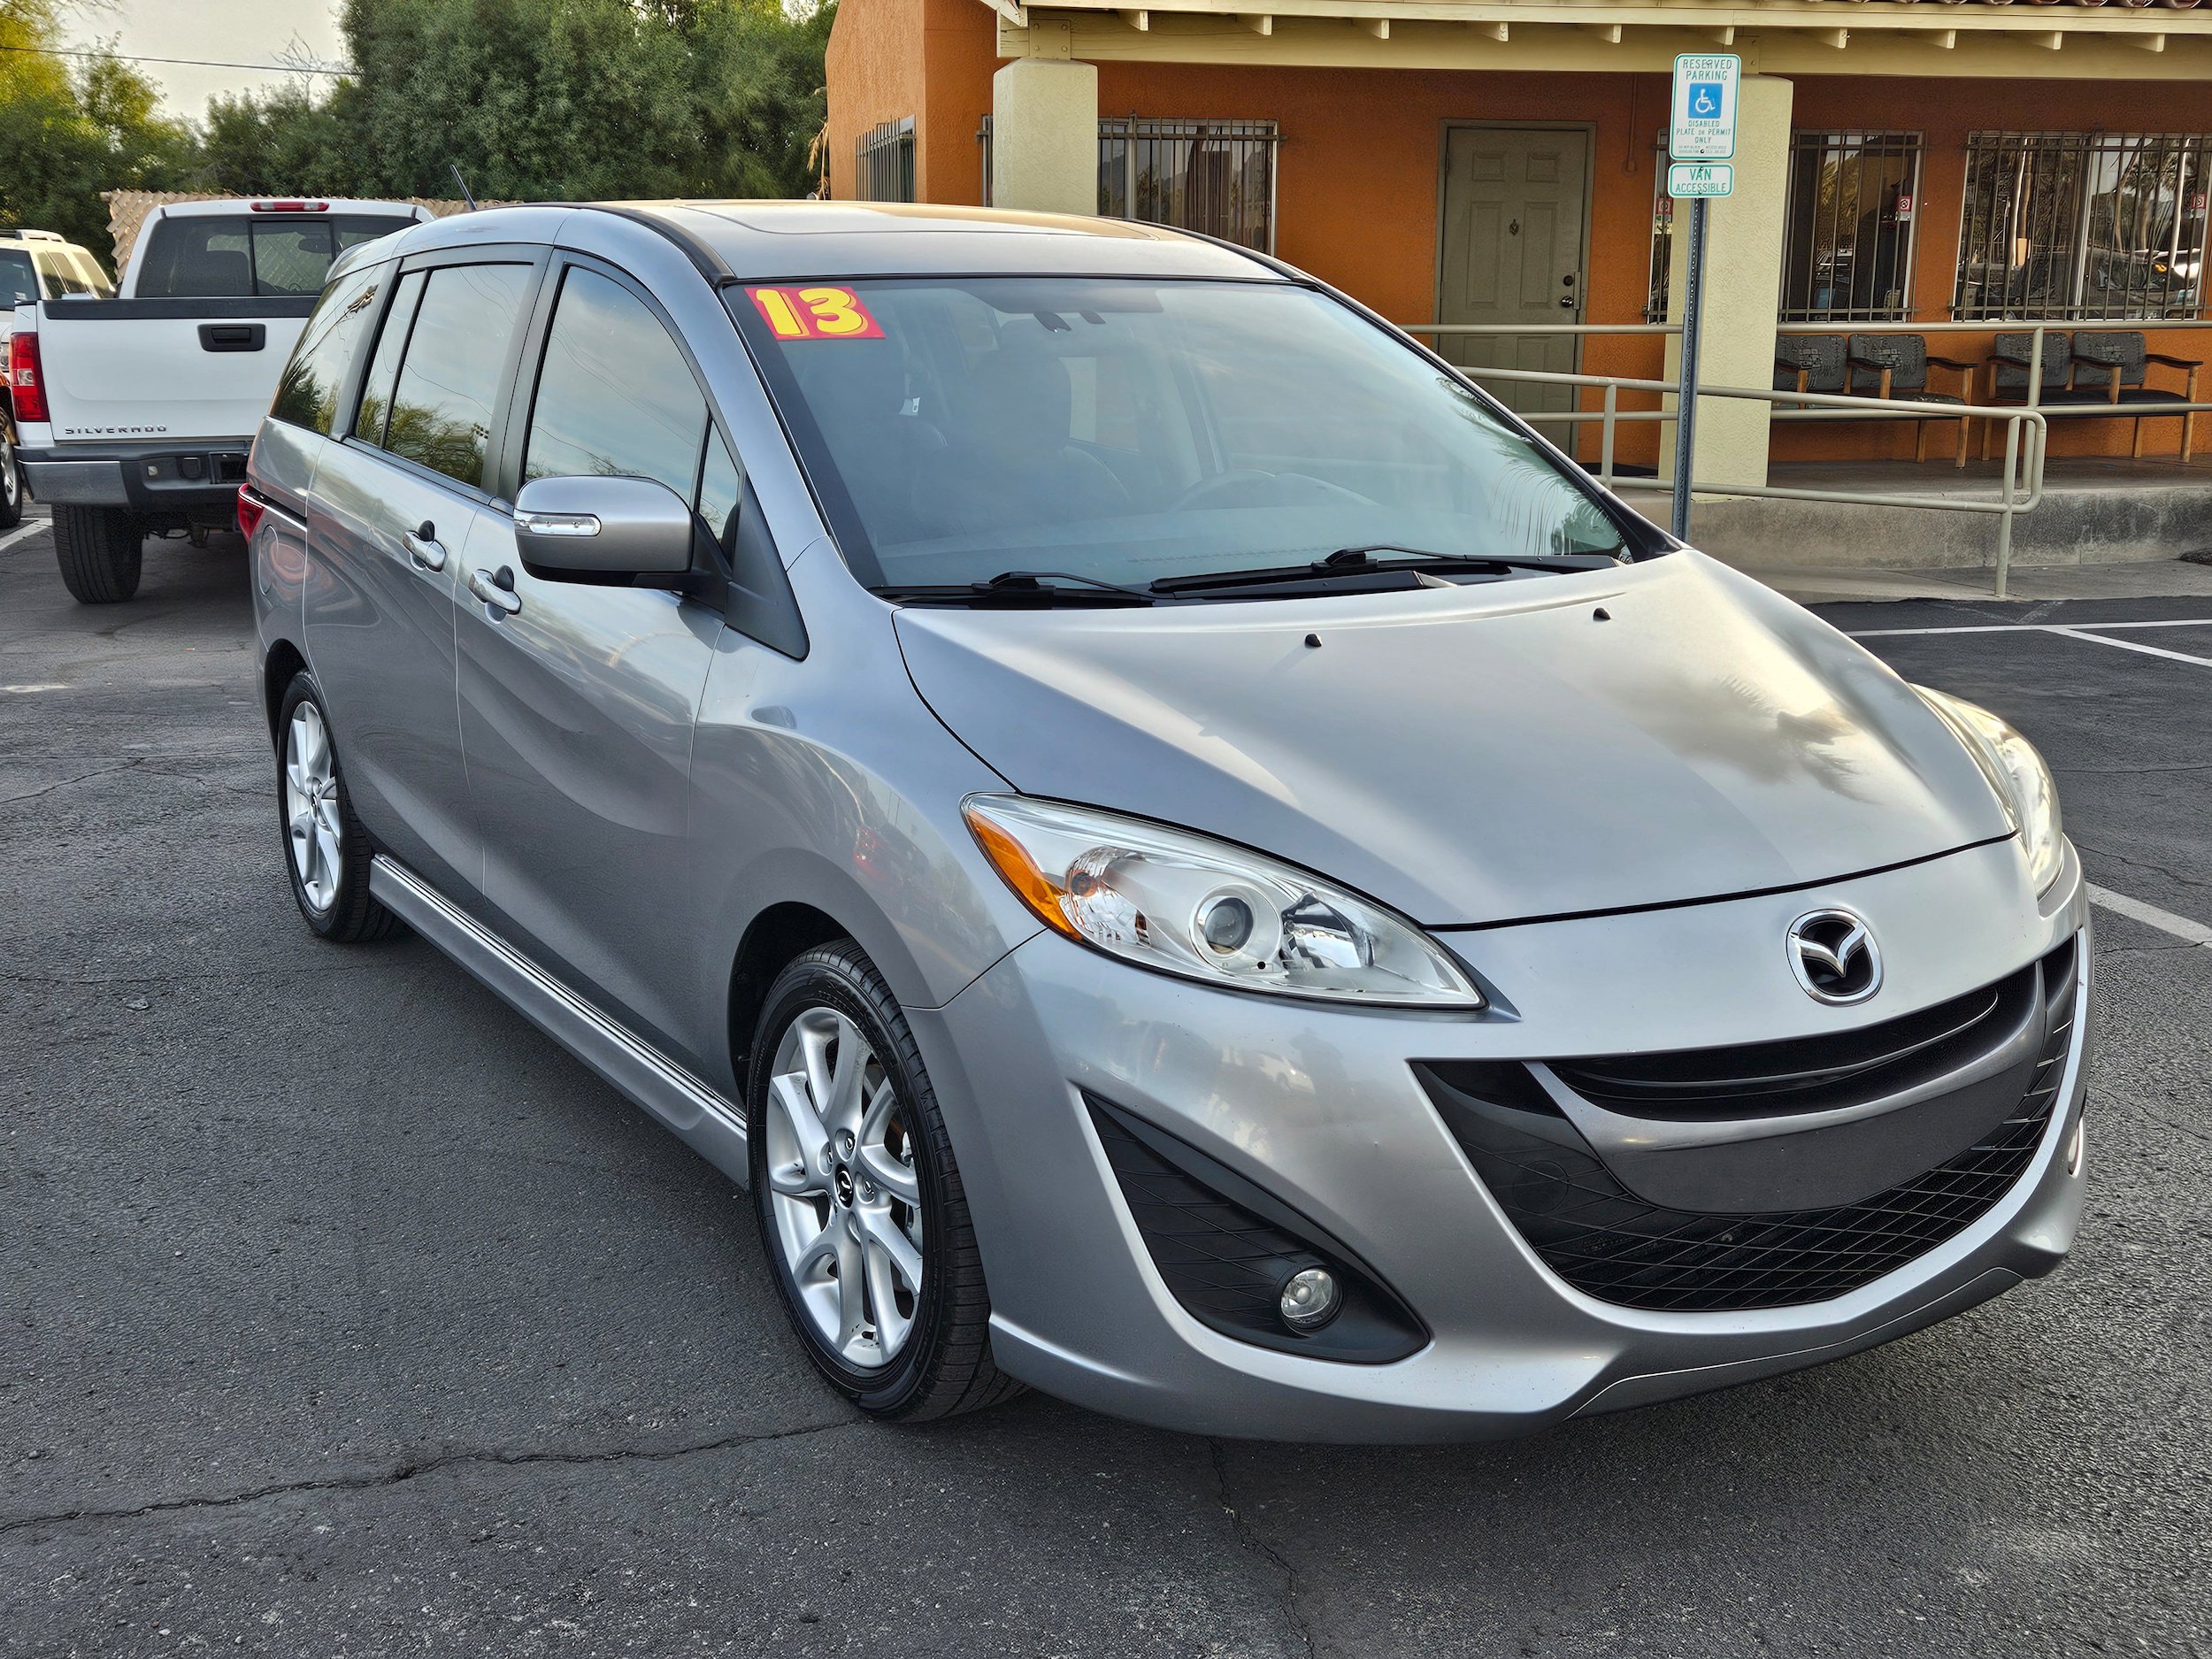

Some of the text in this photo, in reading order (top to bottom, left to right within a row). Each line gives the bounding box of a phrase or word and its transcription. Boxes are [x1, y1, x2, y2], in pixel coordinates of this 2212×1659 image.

[1683, 58, 1732, 69] RESERVED
[1686, 71, 1728, 81] PARKING
[1689, 168, 1712, 180] VAN
[1675, 182, 1726, 193] ACCESSIBLE
[756, 288, 868, 336] 13
[65, 425, 167, 434] SILVERADO
